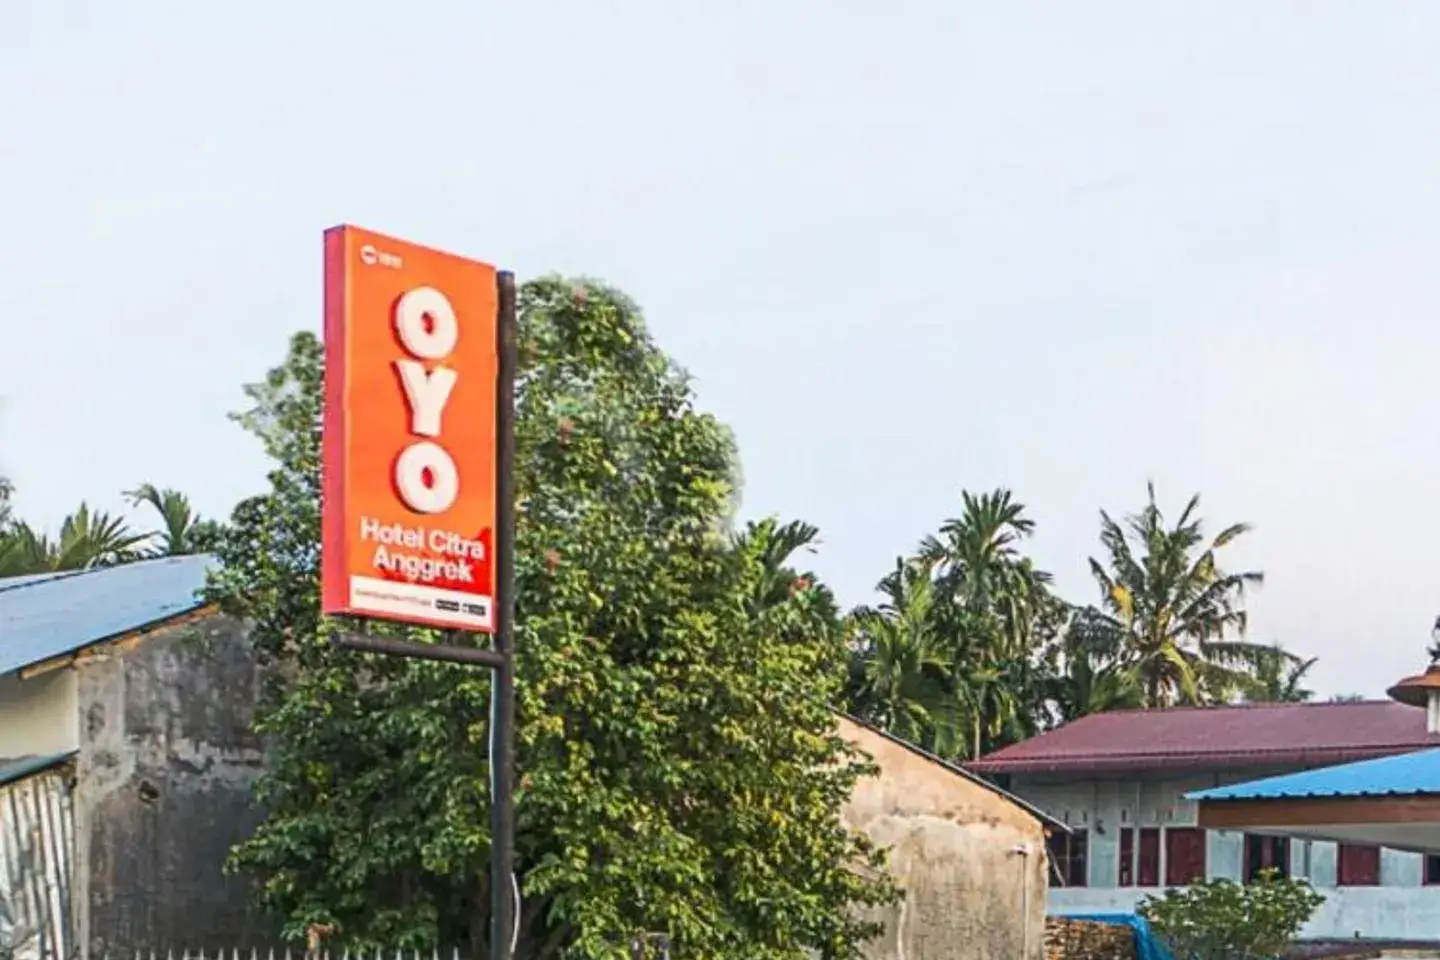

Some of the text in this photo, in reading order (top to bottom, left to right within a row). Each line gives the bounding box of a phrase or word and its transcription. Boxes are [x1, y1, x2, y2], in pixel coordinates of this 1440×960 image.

[393, 285, 458, 514] OYO
[360, 515, 485, 560] Hotel Citra
[373, 544, 474, 583] Anggrek
